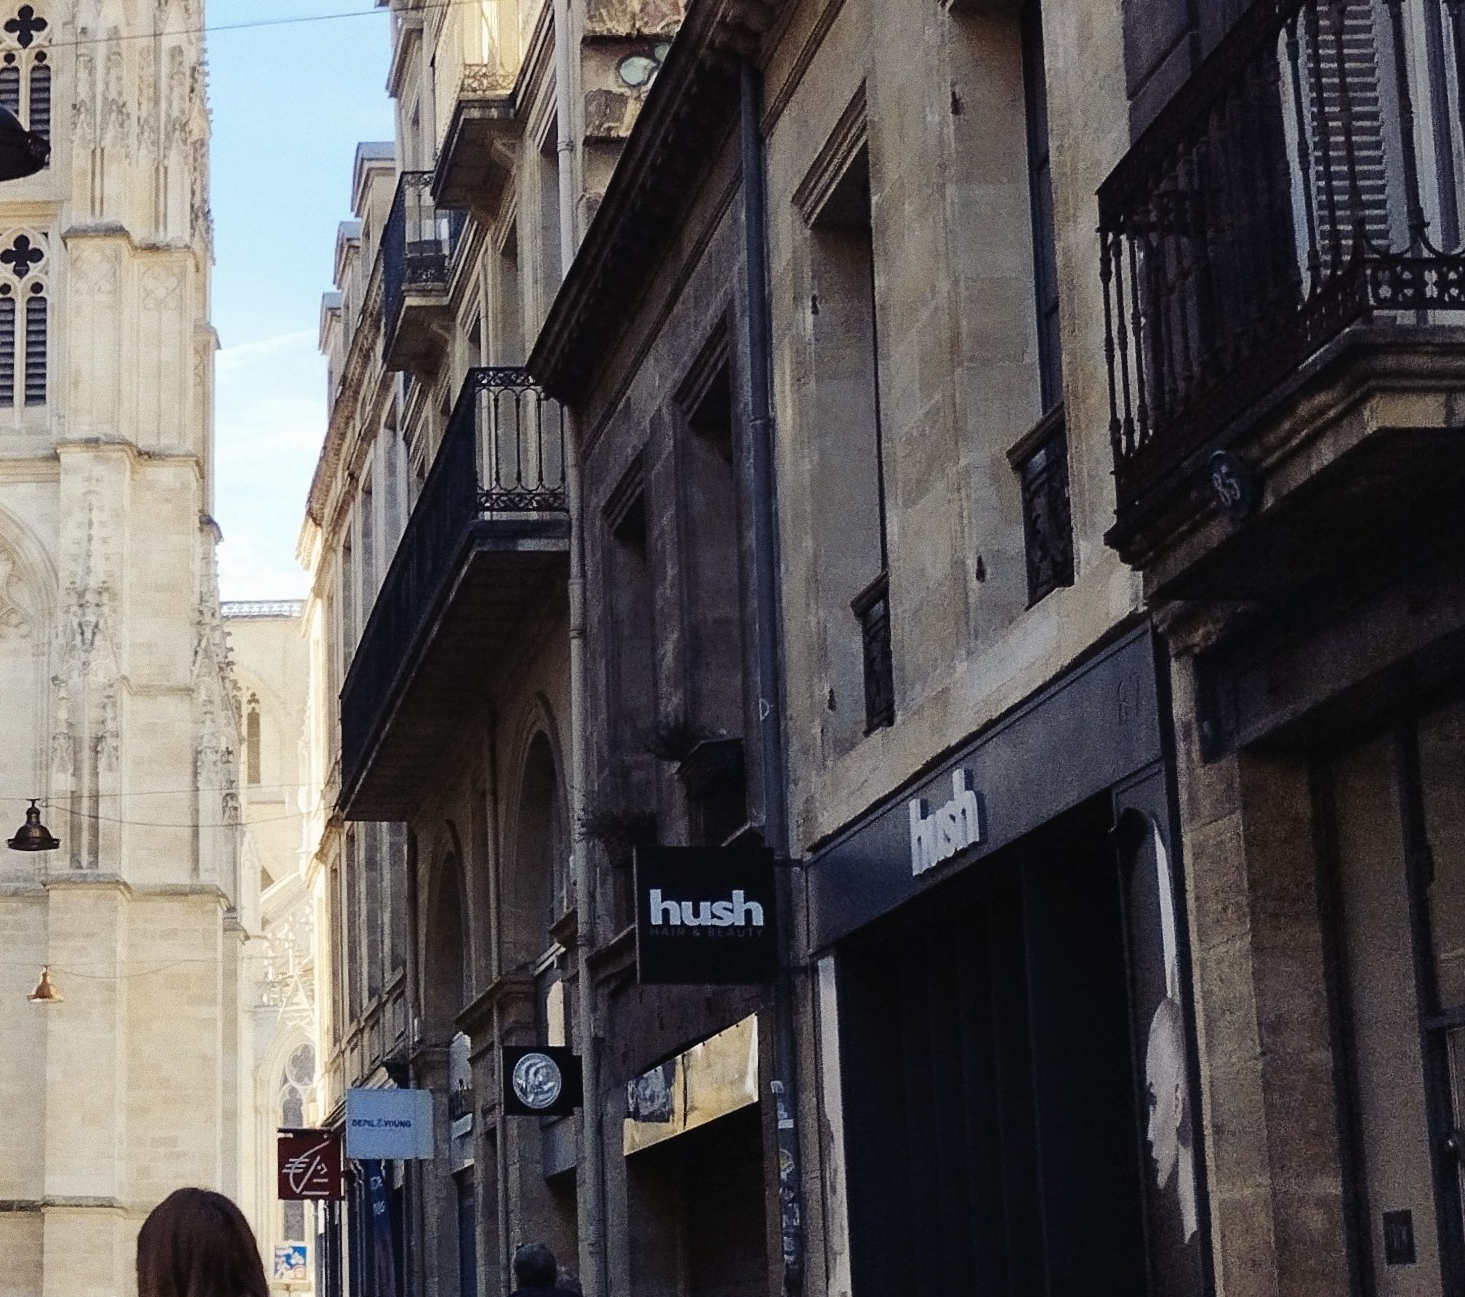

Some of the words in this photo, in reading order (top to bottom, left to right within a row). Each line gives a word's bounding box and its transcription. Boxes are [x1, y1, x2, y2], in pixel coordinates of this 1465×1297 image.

[1212, 464, 1241, 506] 85
[908, 768, 980, 876] hush
[649, 889, 764, 926] hush
[649, 927, 685, 937] HAIR
[692, 927, 700, 937] &
[707, 927, 764, 938] BEAUTY
